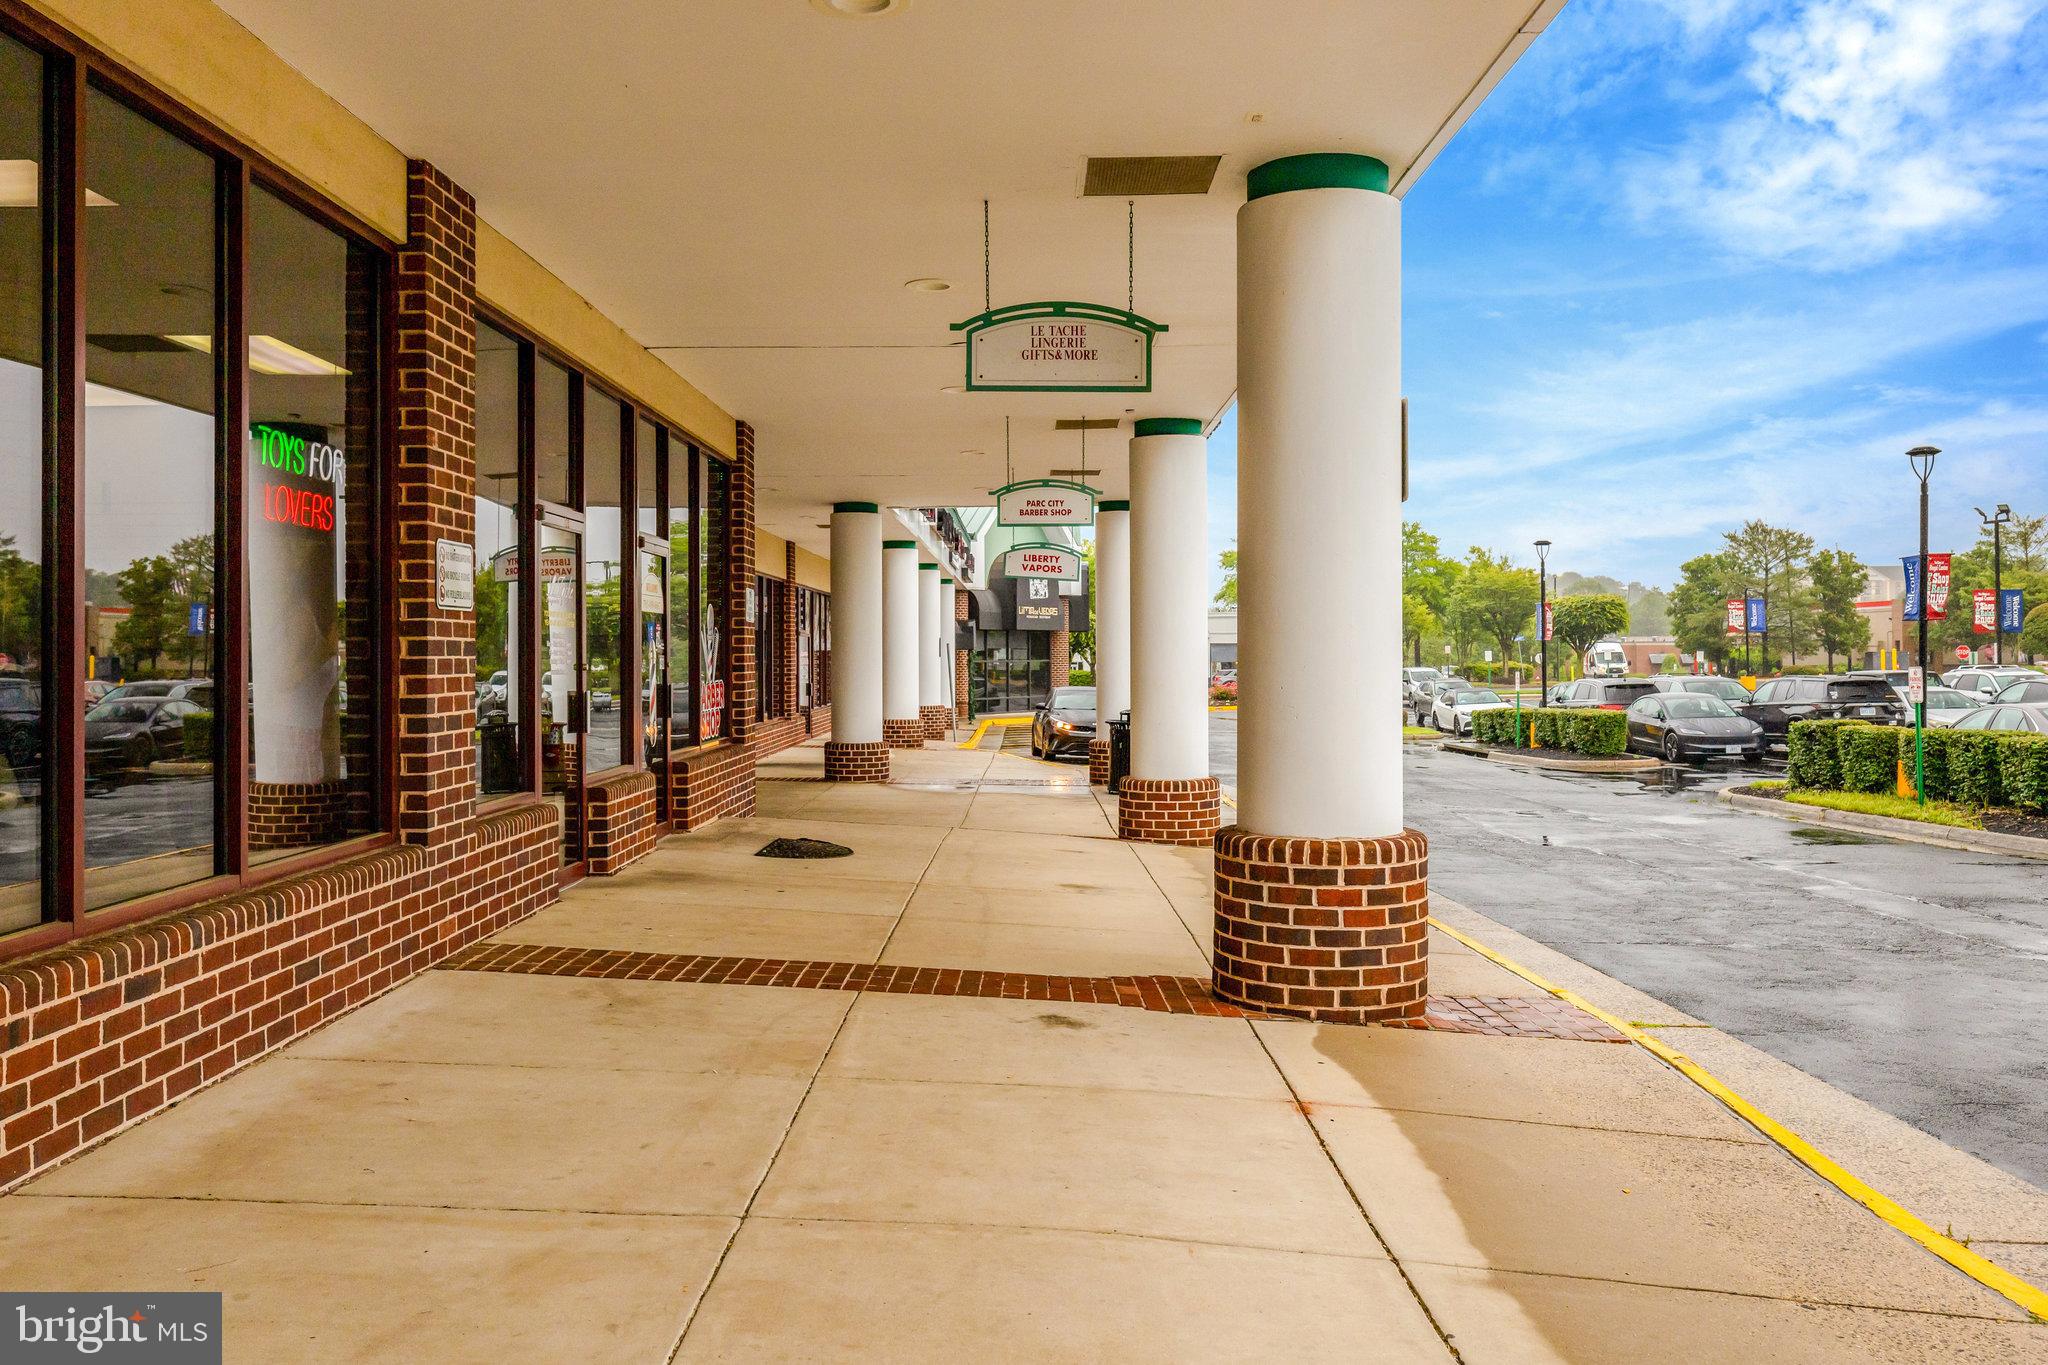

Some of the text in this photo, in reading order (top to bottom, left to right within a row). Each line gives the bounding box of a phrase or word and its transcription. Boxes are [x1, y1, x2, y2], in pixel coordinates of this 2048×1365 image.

[1030, 325, 1087, 336] LE TACHE
[1030, 337, 1087, 348] LINGERIE
[258, 425, 346, 484] TOYS FOR
[264, 483, 334, 531] LOVERS
[1019, 508, 1073, 516] BARBER SHOP
[1023, 554, 1060, 564] LIBERTY
[1022, 564, 1062, 574] VAPORS
[1904, 562, 1916, 614] Welcome
[2012, 595, 2020, 627] Welcome
